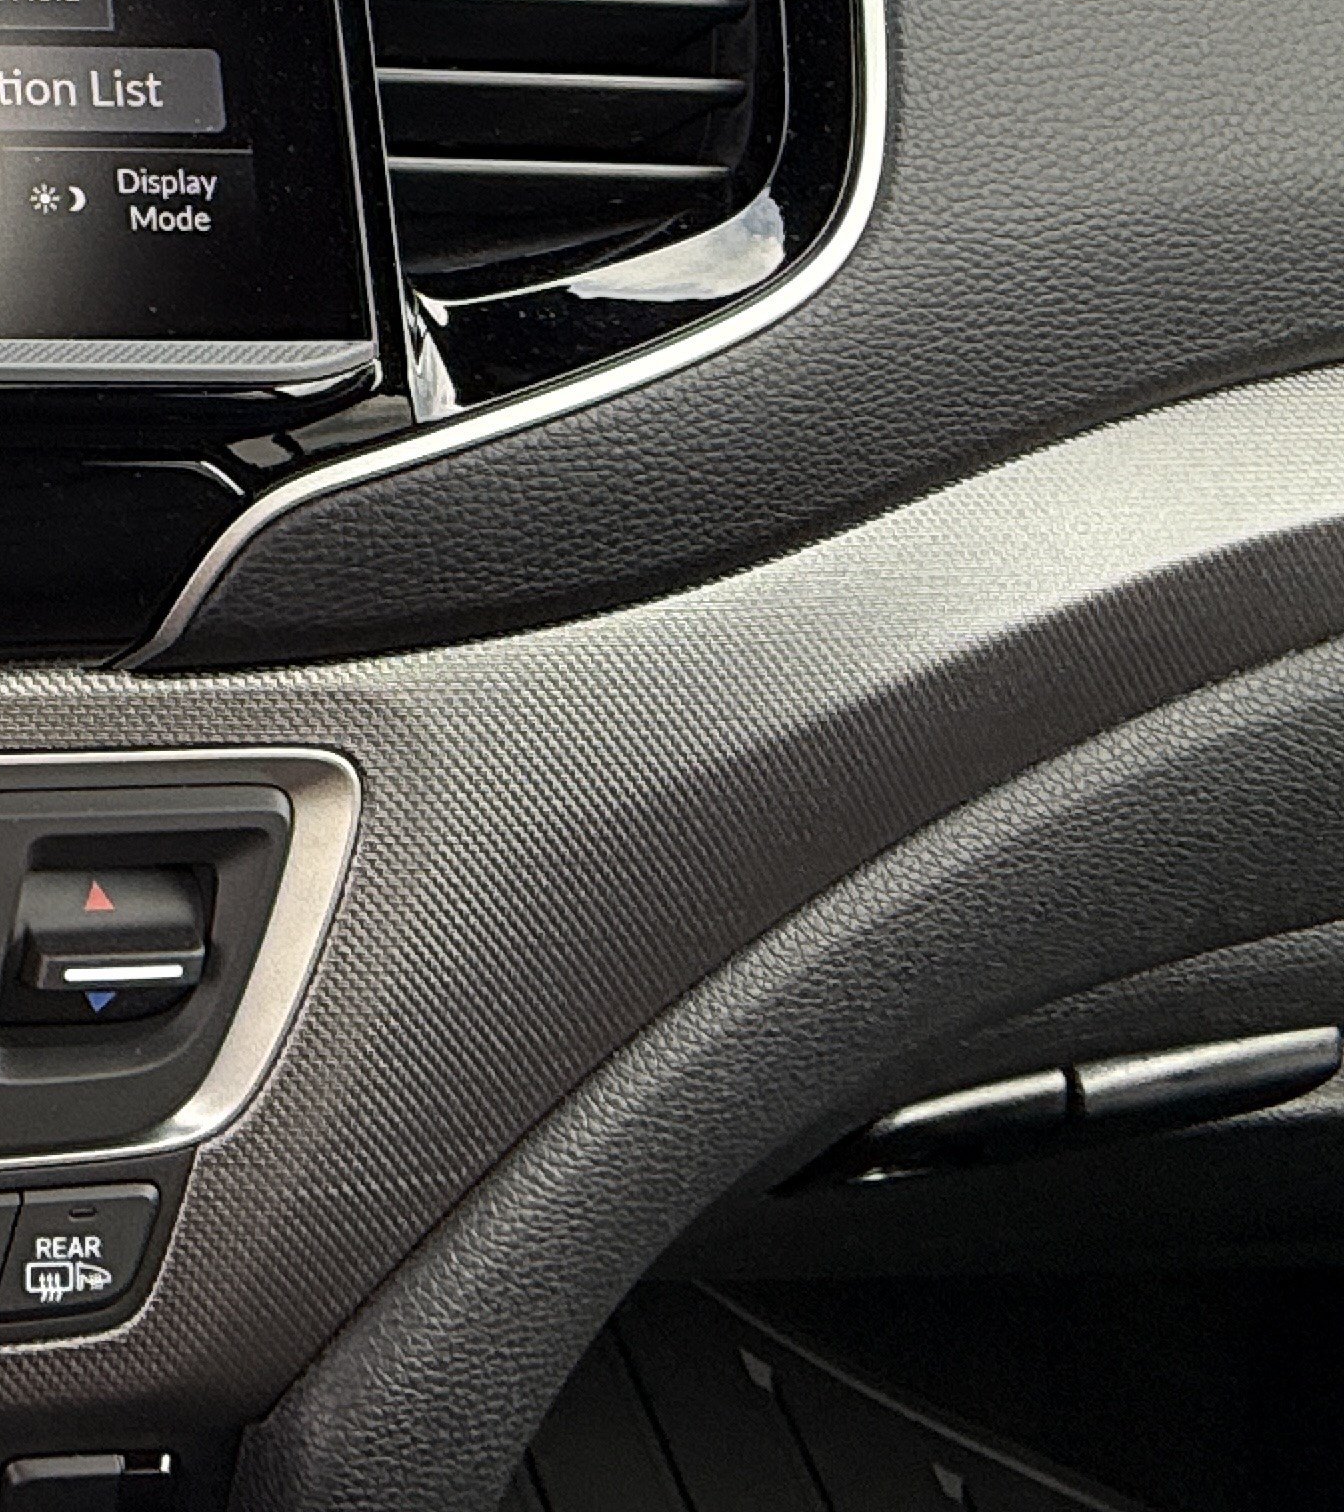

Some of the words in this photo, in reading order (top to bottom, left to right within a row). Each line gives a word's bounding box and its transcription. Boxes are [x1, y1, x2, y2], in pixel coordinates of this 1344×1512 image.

[90, 68, 164, 108] List
[116, 168, 218, 201] Display
[130, 204, 212, 232] Mode
[35, 1235, 102, 1258] REAR
